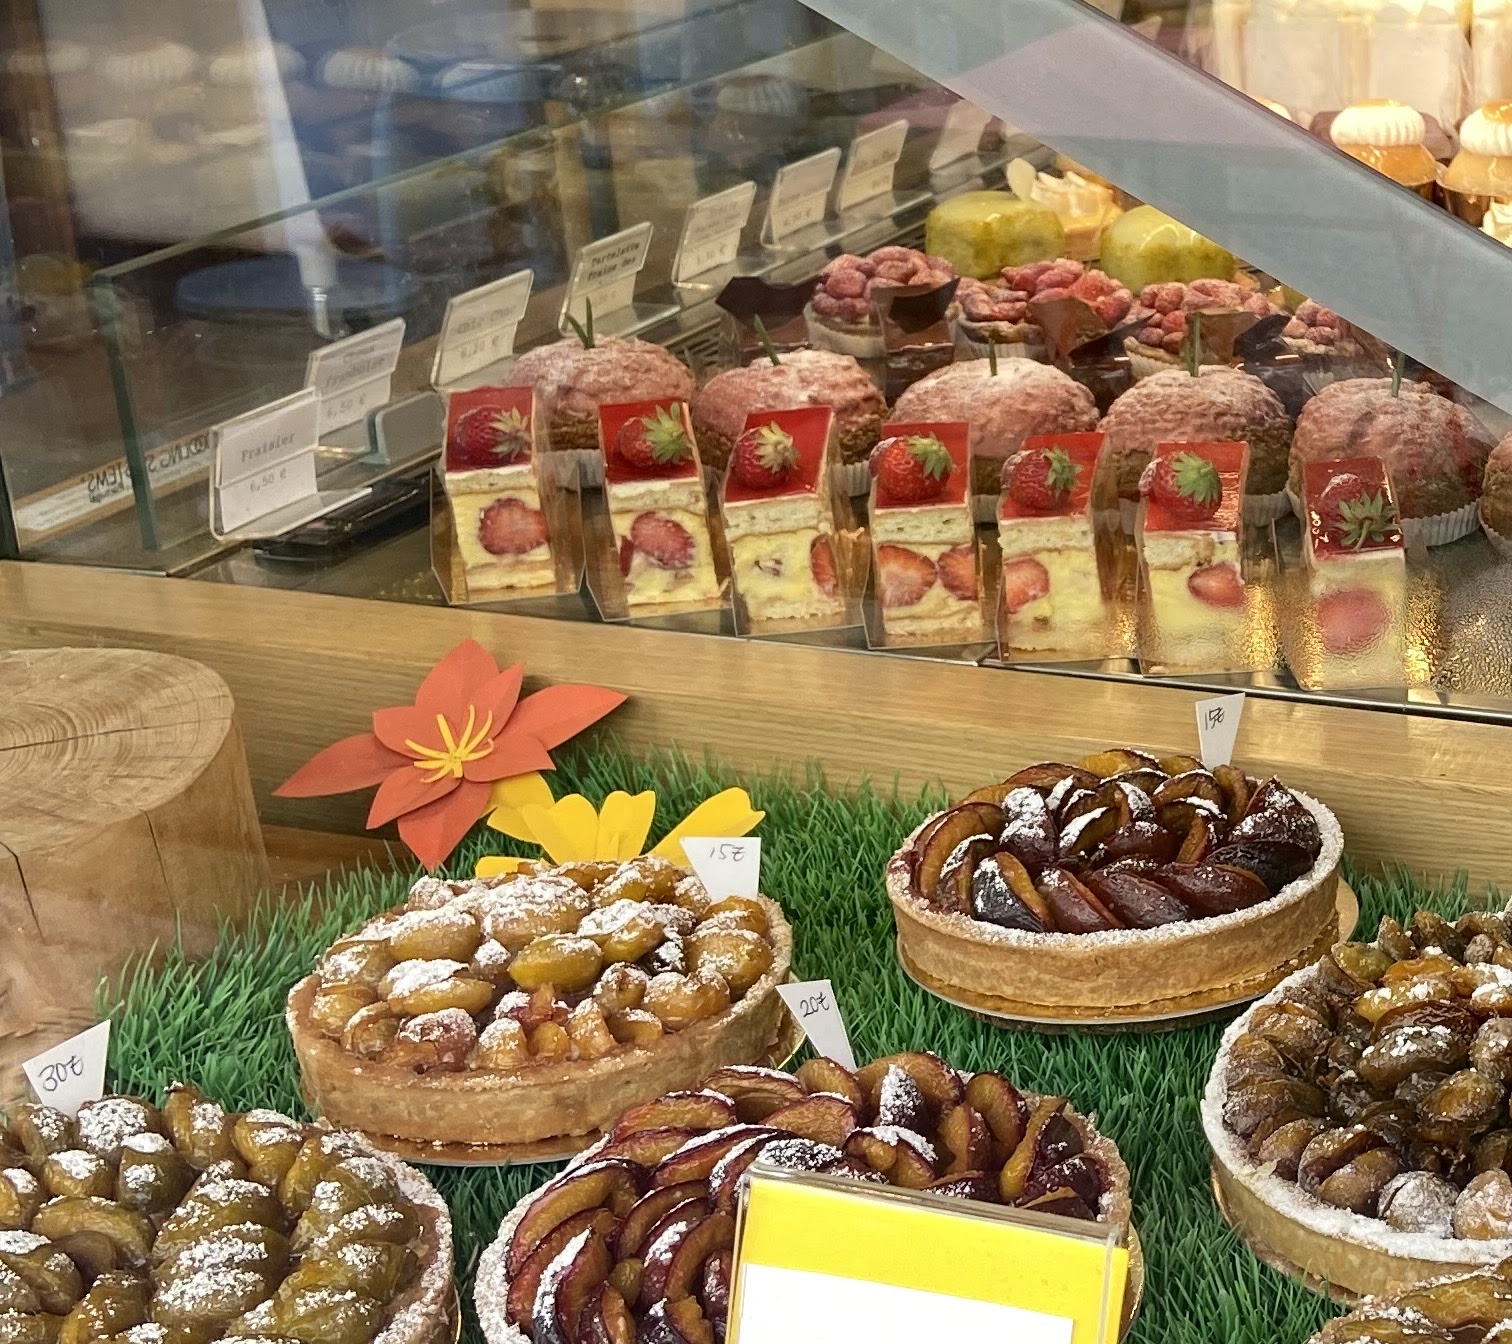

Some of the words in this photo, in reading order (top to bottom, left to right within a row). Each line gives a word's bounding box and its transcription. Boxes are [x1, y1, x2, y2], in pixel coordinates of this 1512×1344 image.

[241, 432, 296, 463] Fraisier
[1205, 706, 1226, 731] 15€
[708, 843, 746, 862] 15€
[799, 991, 831, 1018] 20€
[38, 1054, 85, 1092] 30€
